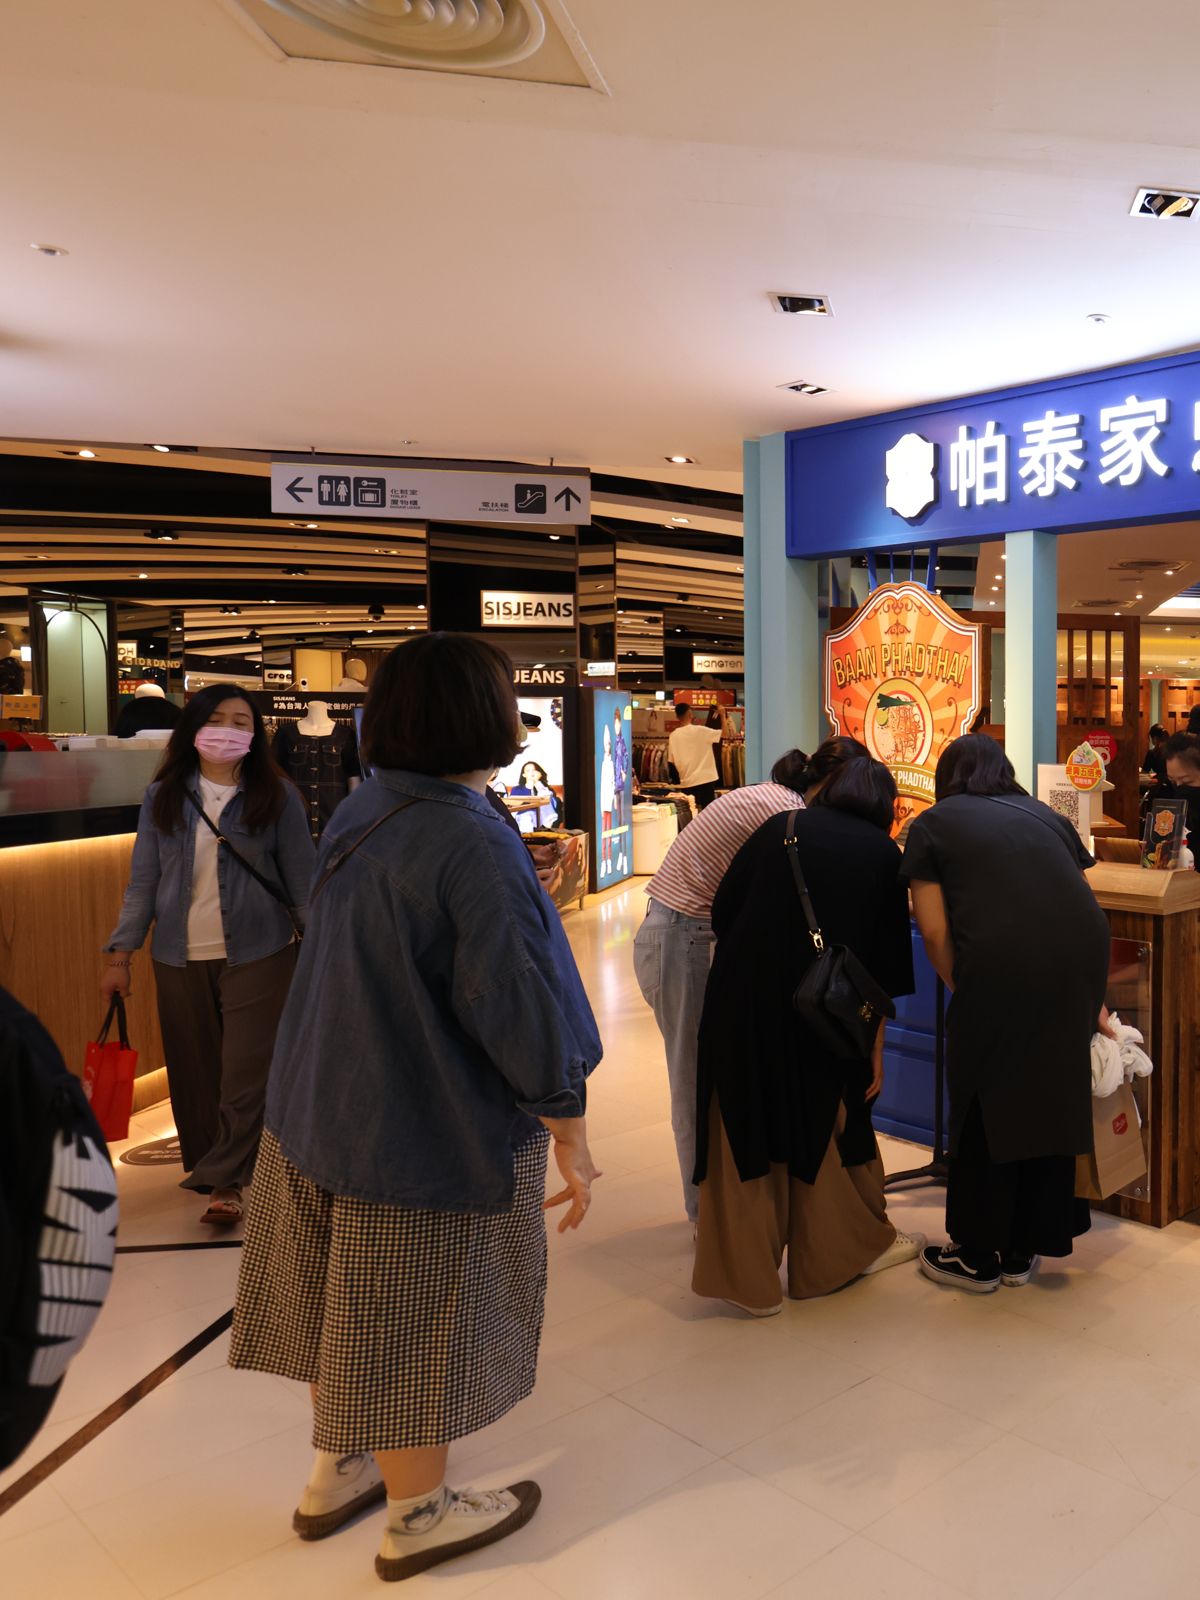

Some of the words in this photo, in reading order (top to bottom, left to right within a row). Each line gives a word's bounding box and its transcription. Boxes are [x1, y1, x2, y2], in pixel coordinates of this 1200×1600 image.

[949, 395, 1169, 507] 帕泰家
[484, 601, 573, 618] SISJEANS
[832, 645, 878, 688] BAAN
[881, 642, 969, 688] PHADTHAI
[267, 672, 292, 680] croc
[514, 670, 565, 684] JEANS
